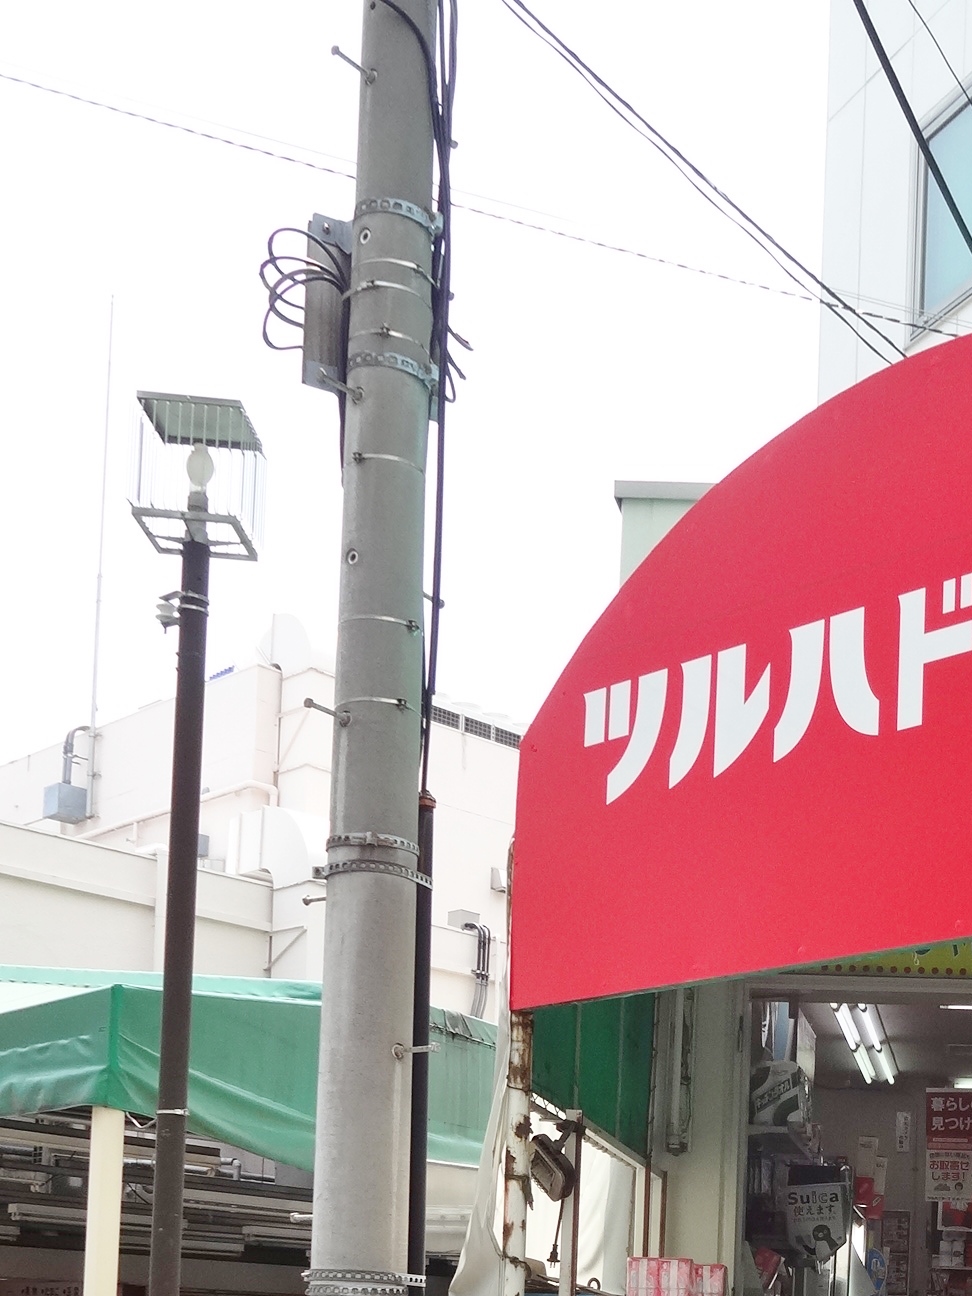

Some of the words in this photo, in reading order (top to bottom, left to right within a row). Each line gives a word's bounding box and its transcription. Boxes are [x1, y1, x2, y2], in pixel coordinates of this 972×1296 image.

[929, 1160, 970, 1171] お取寄せ
[787, 1190, 840, 1206] Suica
